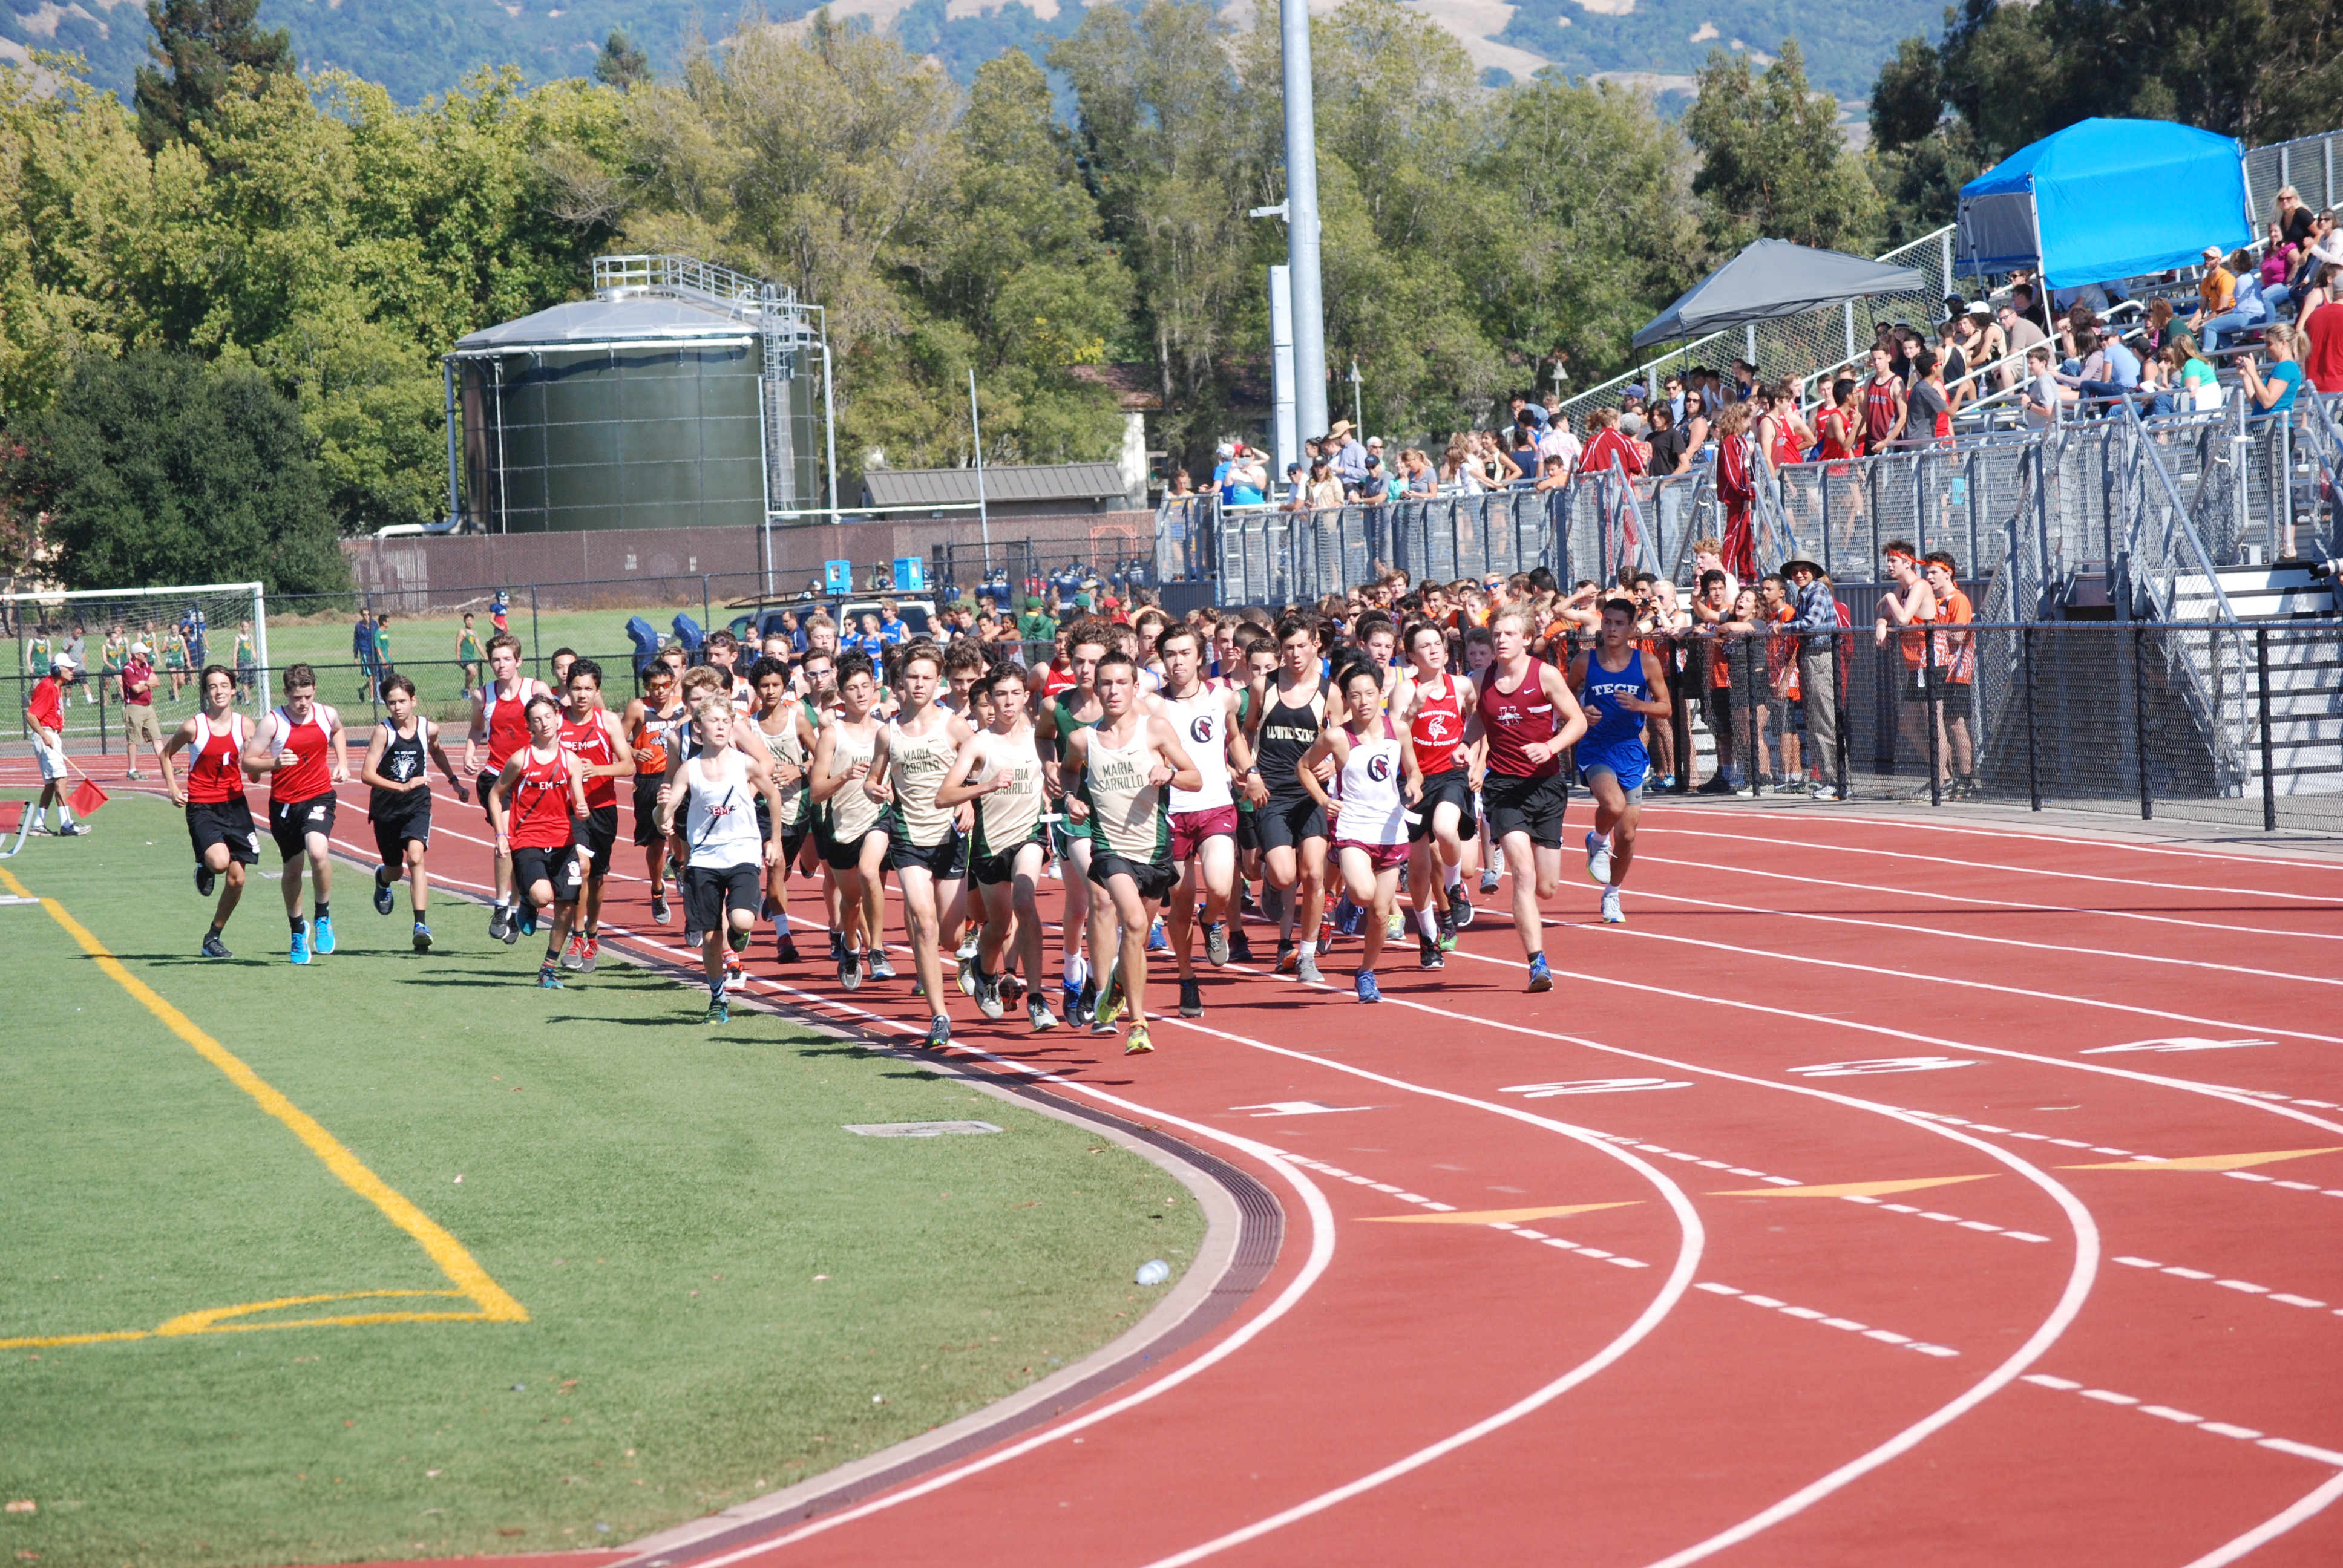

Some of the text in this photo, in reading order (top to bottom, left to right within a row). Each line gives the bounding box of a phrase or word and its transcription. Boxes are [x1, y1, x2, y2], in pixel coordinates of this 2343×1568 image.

[1592, 684, 1640, 696] TECH
[646, 720, 667, 733] SANTA
[1267, 725, 1316, 742] WINDSOR
[851, 756, 872, 766] MARI
[903, 748, 931, 762] MARIA
[901, 760, 940, 775] CARRILLO
[1102, 761, 1134, 777] MARIA
[539, 782, 554, 790] EM
[1098, 774, 1144, 793] CARRILLO
[712, 806, 730, 817] EM
